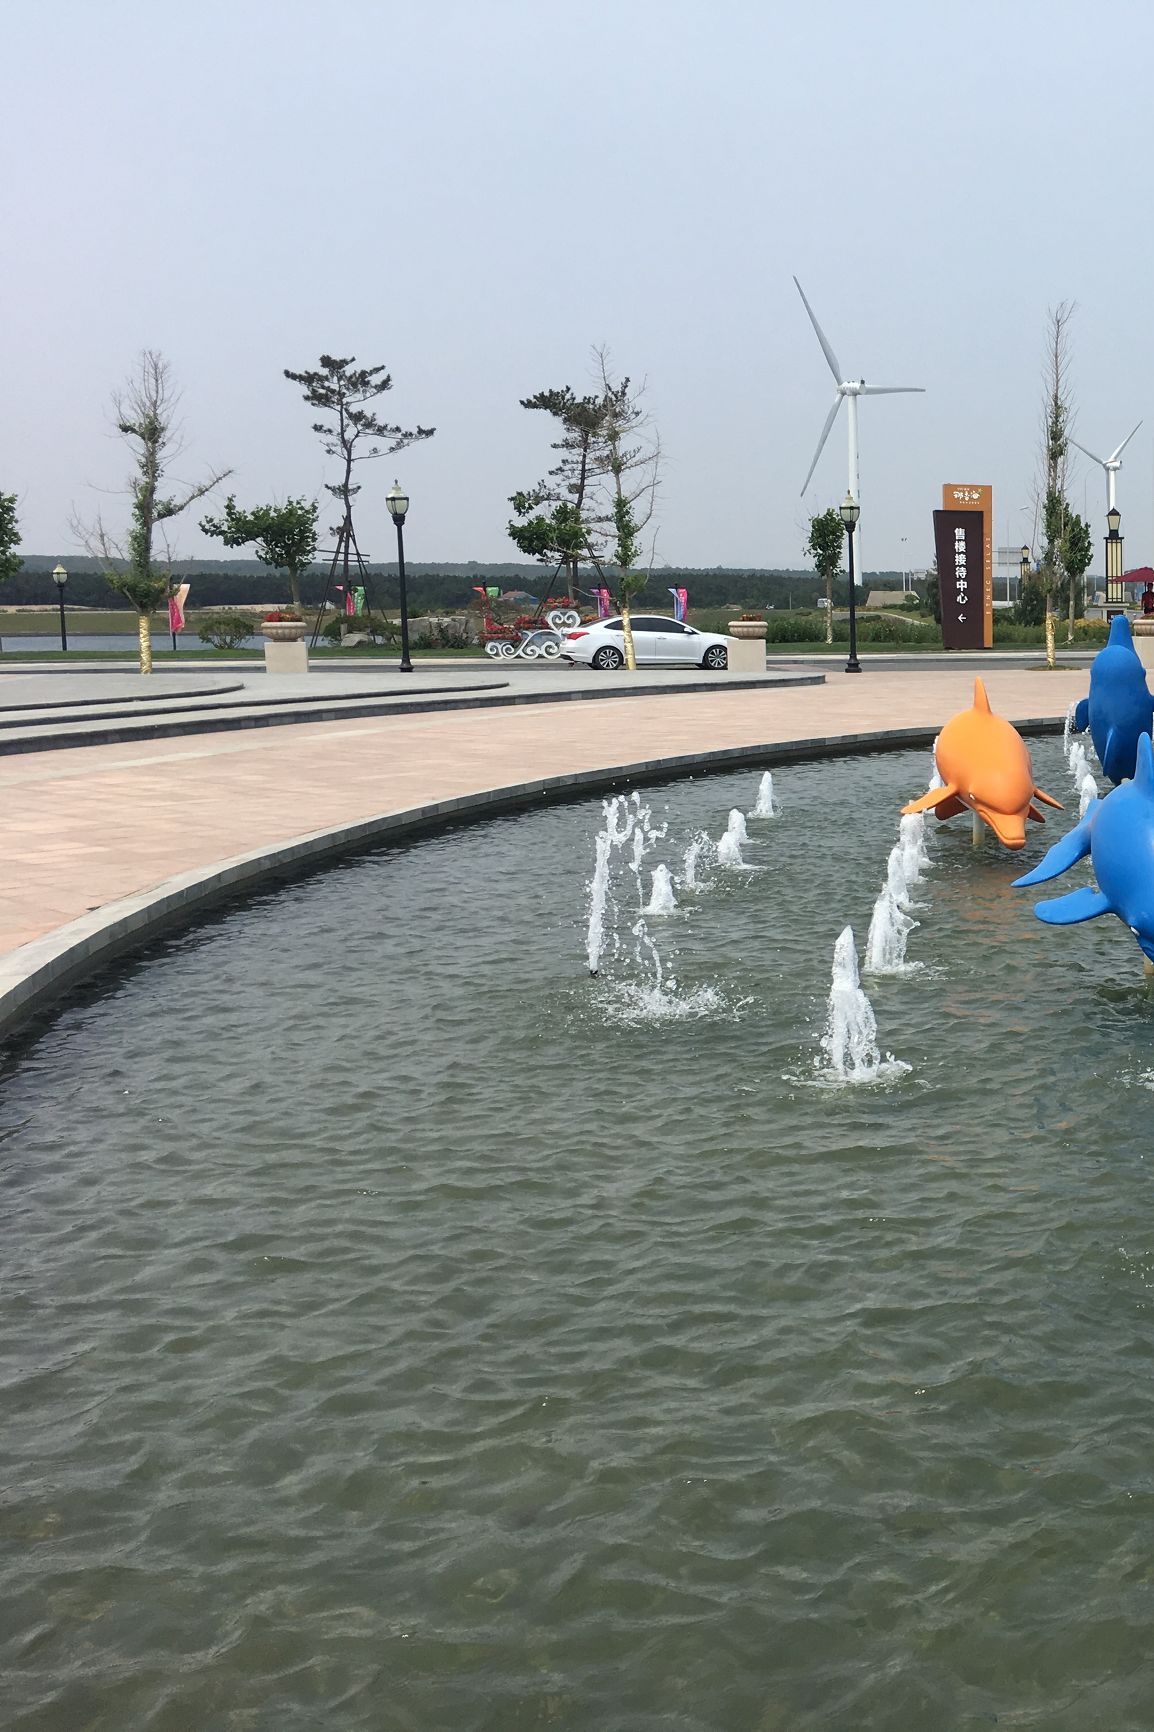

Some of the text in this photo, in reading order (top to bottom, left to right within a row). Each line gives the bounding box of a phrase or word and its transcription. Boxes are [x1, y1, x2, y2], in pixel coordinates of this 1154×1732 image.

[954, 527, 969, 604] 售楼接待中心
